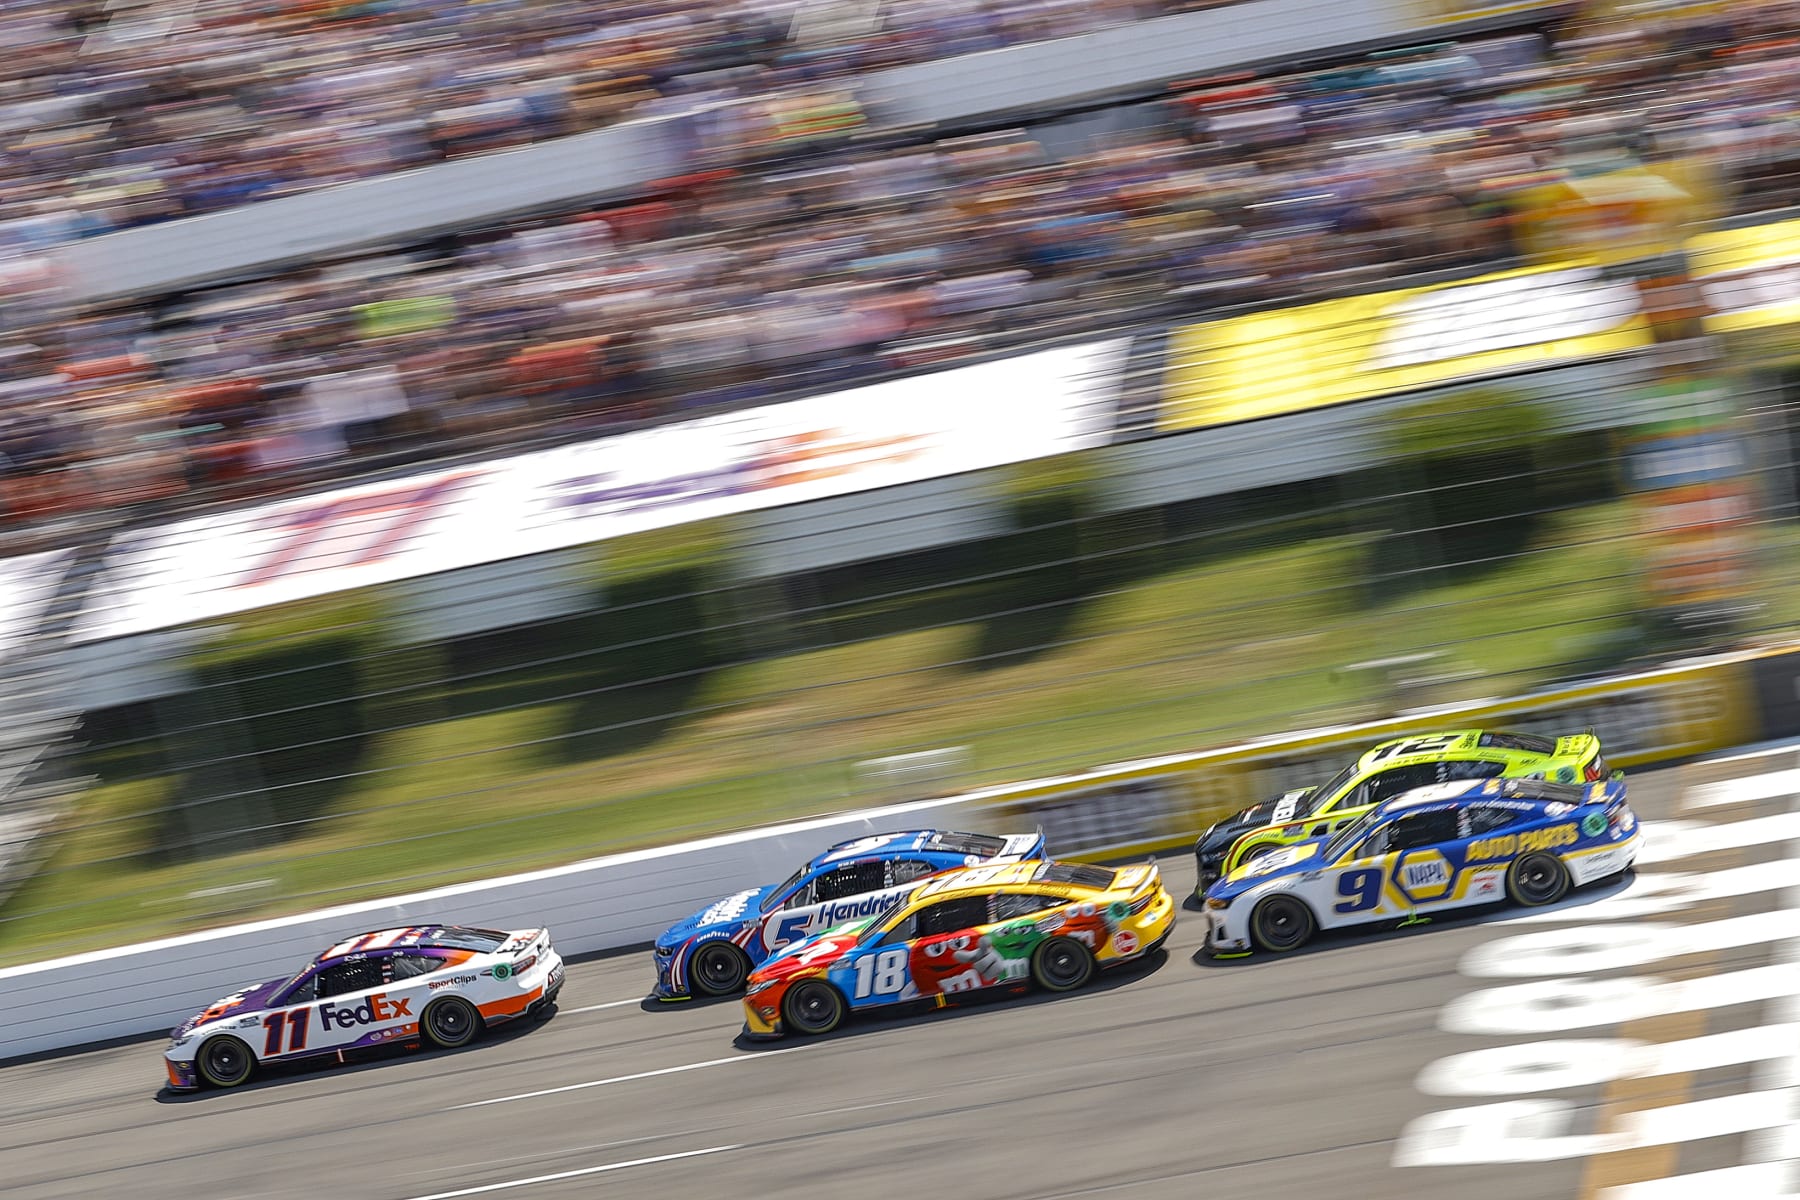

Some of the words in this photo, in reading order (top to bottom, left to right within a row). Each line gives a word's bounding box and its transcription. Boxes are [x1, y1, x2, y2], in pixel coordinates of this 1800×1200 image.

[1371, 734, 1462, 763] 12
[1465, 834, 1519, 862] AUTO
[1518, 822, 1579, 853] PARTS
[1335, 868, 1382, 913] 9
[769, 913, 814, 953] 5
[428, 974, 477, 990] SportClips
[854, 949, 910, 999] 18
[263, 1006, 312, 1056] 11
[319, 992, 413, 1032] FedEx
